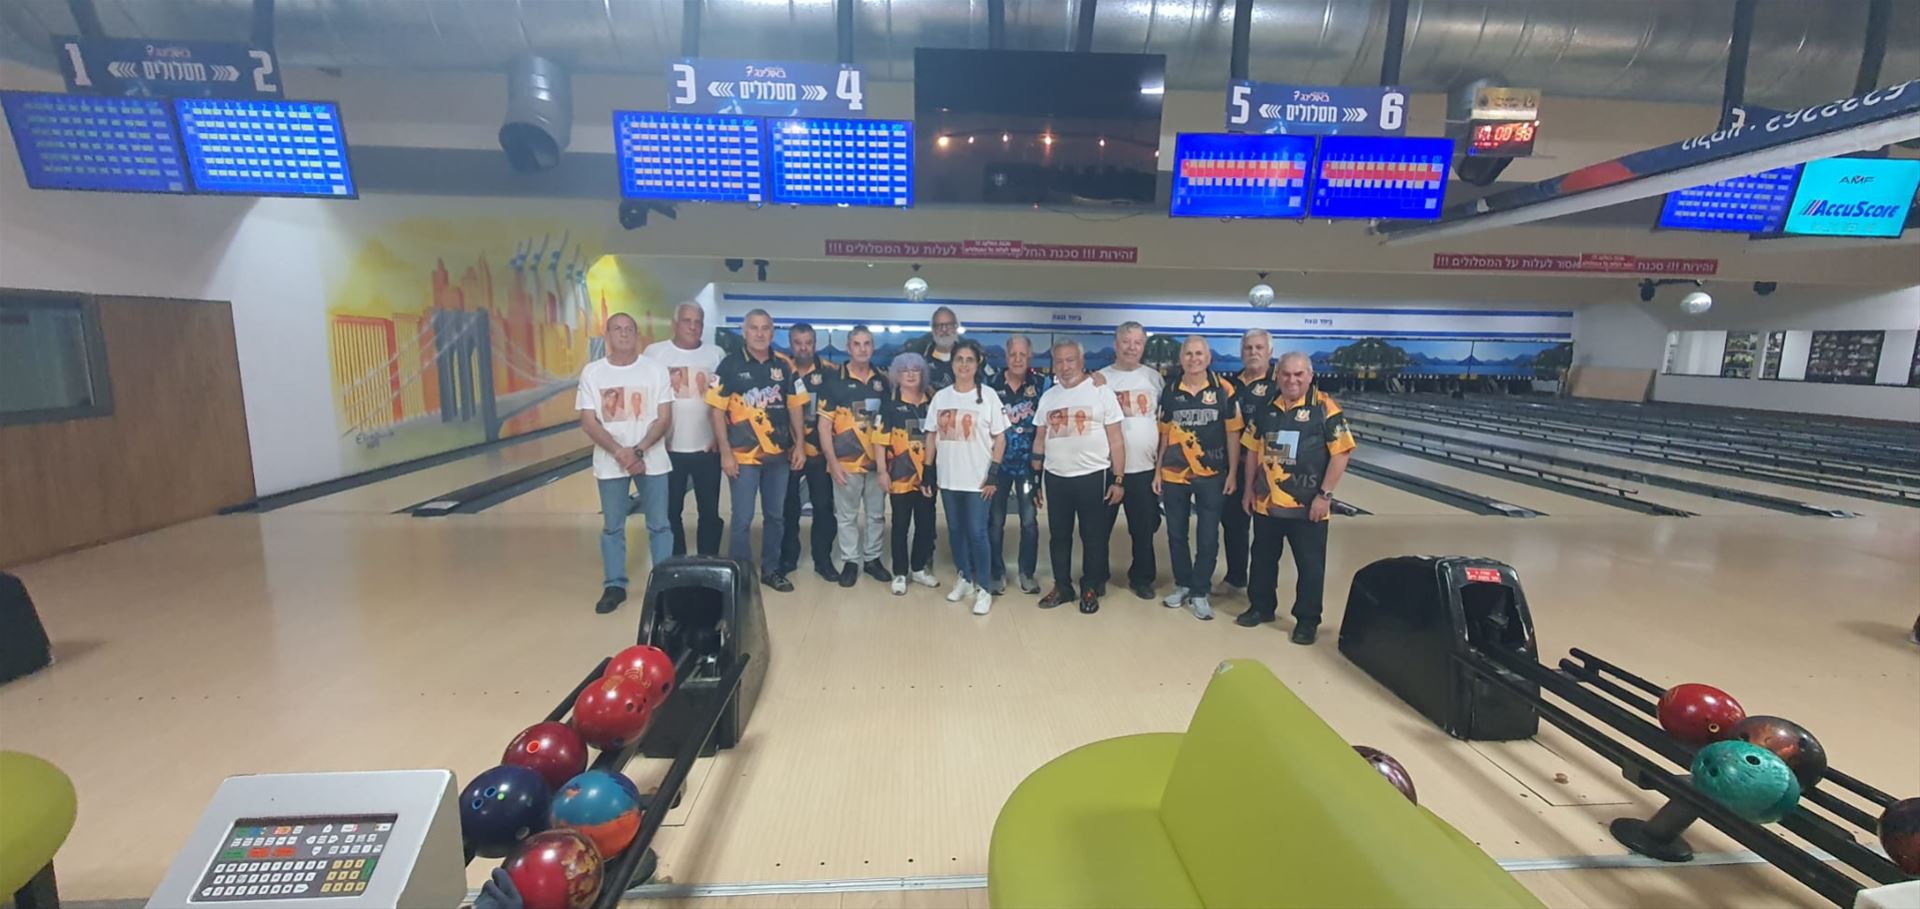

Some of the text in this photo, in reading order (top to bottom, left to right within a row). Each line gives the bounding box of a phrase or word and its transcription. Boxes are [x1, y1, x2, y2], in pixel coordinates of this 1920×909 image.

[65, 43, 277, 92] 1 מסלולים 2
[673, 64, 864, 110] 3 מסלולים 4
[1231, 86, 1404, 130] 5 מסלולים 6
[1840, 175, 1875, 184] AMF
[1808, 199, 1900, 218] AccuScore
[845, 243, 901, 254] המסלולים
[904, 242, 920, 256] על
[923, 243, 957, 256] לעלות
[1050, 248, 1079, 259] סכנת
[1099, 250, 1136, 260] זהירות
[1451, 255, 1502, 268] המסלולים
[1505, 256, 1519, 269] על
[1522, 257, 1553, 269] לעלות
[1638, 261, 1664, 271] סכנת
[1683, 262, 1714, 272] זהירות
